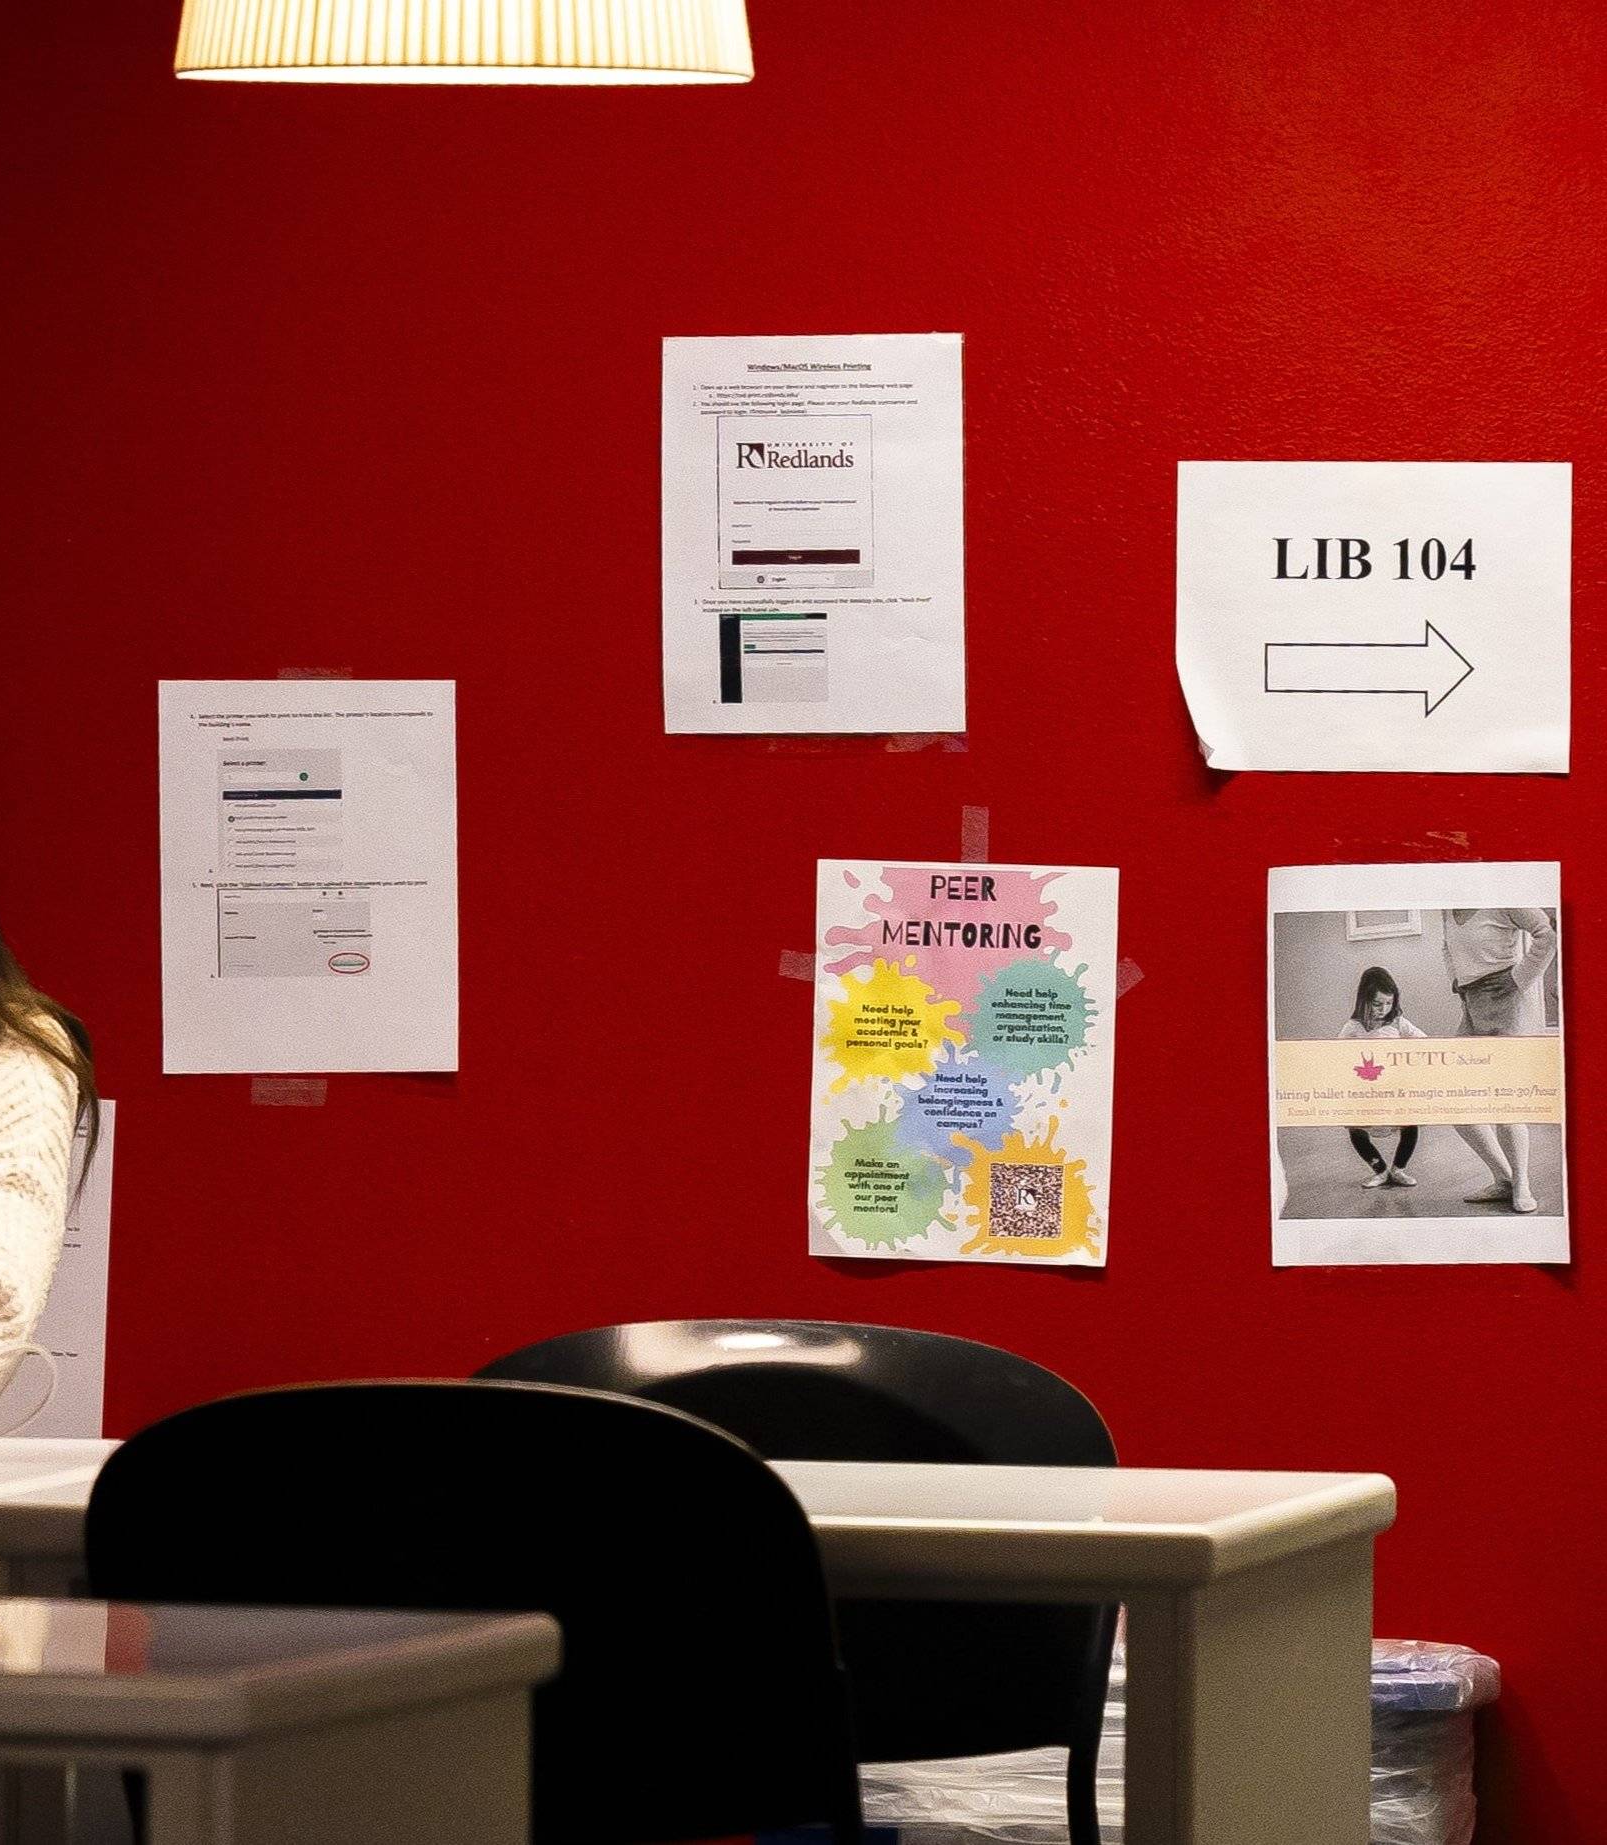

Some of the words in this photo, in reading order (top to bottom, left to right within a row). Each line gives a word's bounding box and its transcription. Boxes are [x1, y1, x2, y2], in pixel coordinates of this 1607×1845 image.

[842, 362, 872, 371] Printing
[766, 450, 854, 468] Redlands
[1270, 537, 1373, 580] LIB
[1393, 537, 1477, 581] 104
[930, 874, 997, 901] PEER
[882, 920, 1042, 948] MENTORING
[1006, 988, 1032, 998] Need
[1035, 988, 1058, 1000] help
[862, 1004, 889, 1014] Need
[892, 1004, 914, 1016] help
[992, 1000, 1046, 1012] enhancing
[1048, 1000, 1072, 1010] time
[854, 1016, 896, 1026] meeting
[899, 1018, 921, 1028] your
[995, 1012, 1068, 1023] management,
[856, 1027, 908, 1037] academic
[912, 1028, 918, 1037] &
[996, 1022, 1066, 1034] organization,
[846, 1038, 892, 1048] personal
[895, 1038, 928, 1050] goals?
[992, 1034, 1006, 1042] or
[1008, 1034, 1034, 1046] study
[1038, 1034, 1070, 1044] skills?
[1386, 1050, 1456, 1068] TUTU
[1456, 1052, 1492, 1066] School
[935, 1074, 963, 1084] Need
[965, 1074, 988, 1086] help
[934, 1084, 988, 1098] increasing
[1276, 1088, 1310, 1102] hiring
[1312, 1086, 1344, 1100] ballet
[1348, 1086, 1394, 1099] teachers
[1398, 1088, 1406, 1098] &
[1408, 1086, 1446, 1100] magic
[1446, 1086, 1492, 1098] makers!
[918, 1096, 994, 1109] belongingness
[996, 1097, 1004, 1106] &
[924, 1108, 982, 1118] confidence
[984, 1109, 997, 1118] on
[936, 1118, 984, 1131] campus?
[854, 1158, 884, 1168] Make
[886, 1160, 900, 1168] an
[844, 1170, 910, 1182] appointment
[848, 1180, 871, 1190] with
[873, 1182, 892, 1190] one
[894, 1180, 906, 1190] of
[854, 1193, 872, 1202] our
[874, 1193, 898, 1204] peer
[853, 1203, 899, 1214] mentors!
